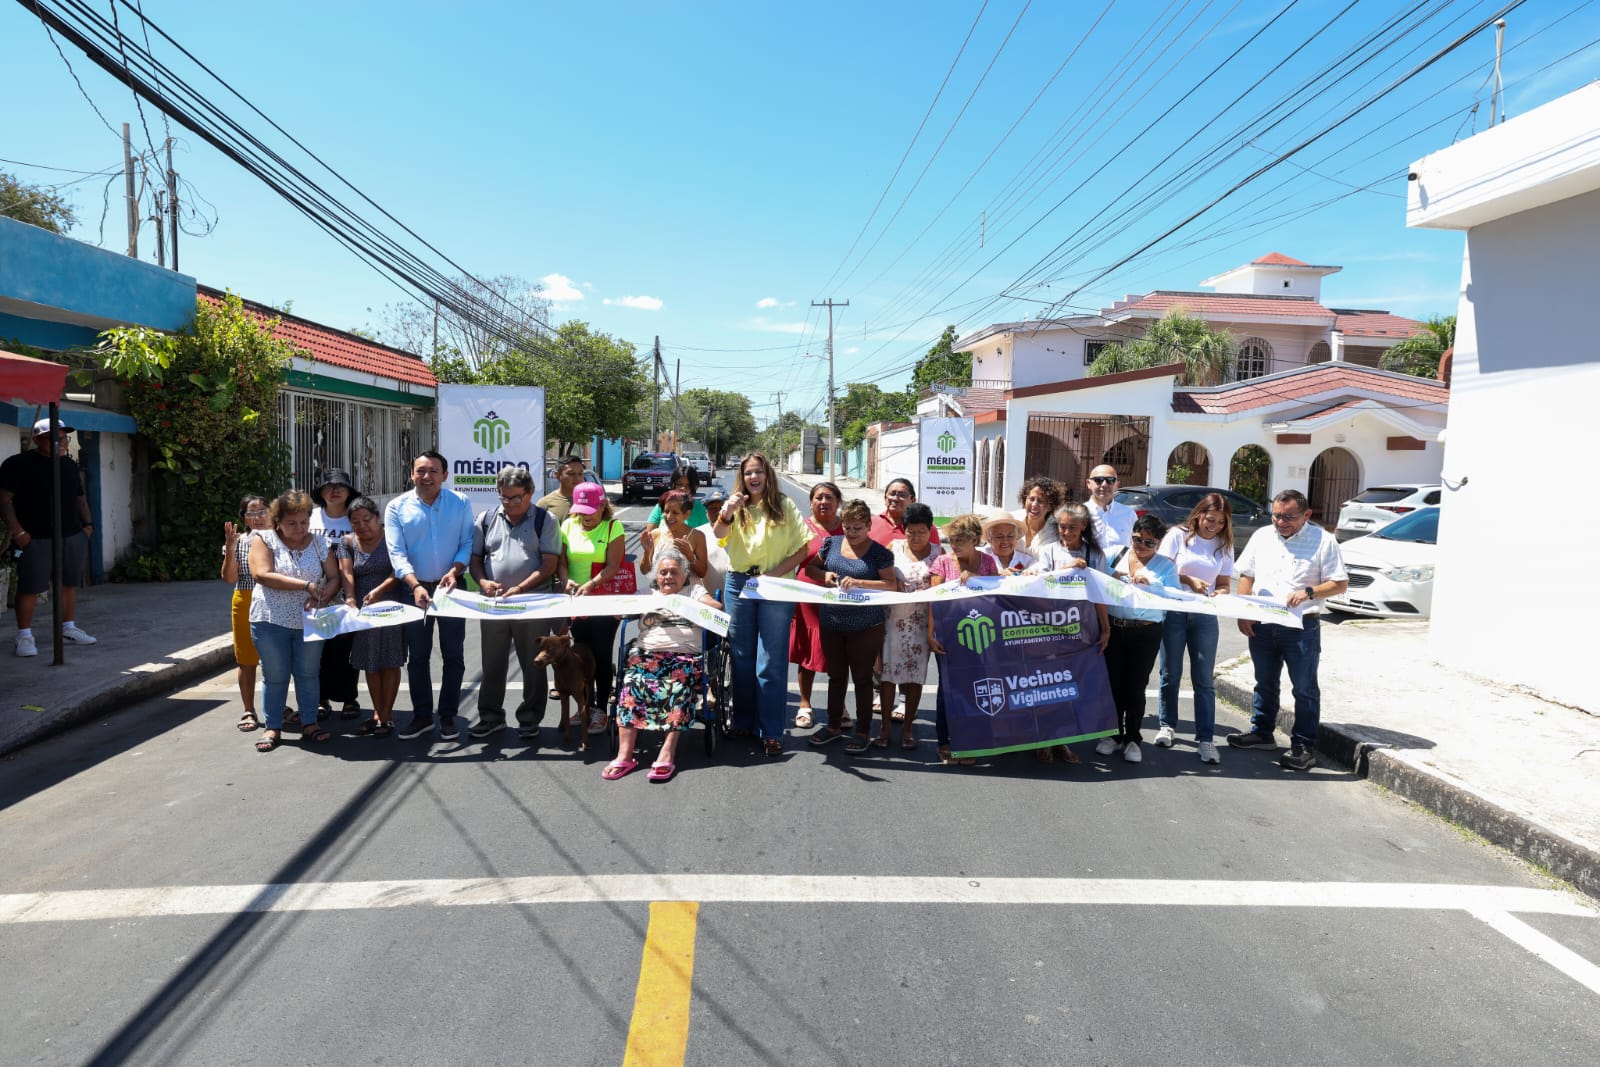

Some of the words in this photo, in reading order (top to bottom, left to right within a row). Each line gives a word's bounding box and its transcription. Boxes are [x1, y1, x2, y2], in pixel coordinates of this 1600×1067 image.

[927, 456, 966, 465] MÉRIDA
[1000, 606, 1081, 627] MÉRIDA
[1004, 628, 1040, 637] CONTIGO
[1004, 636, 1051, 646] AYUNTAMIENTO
[1005, 669, 1073, 690] Vecinos
[1009, 685, 1077, 707] Vigilantes
